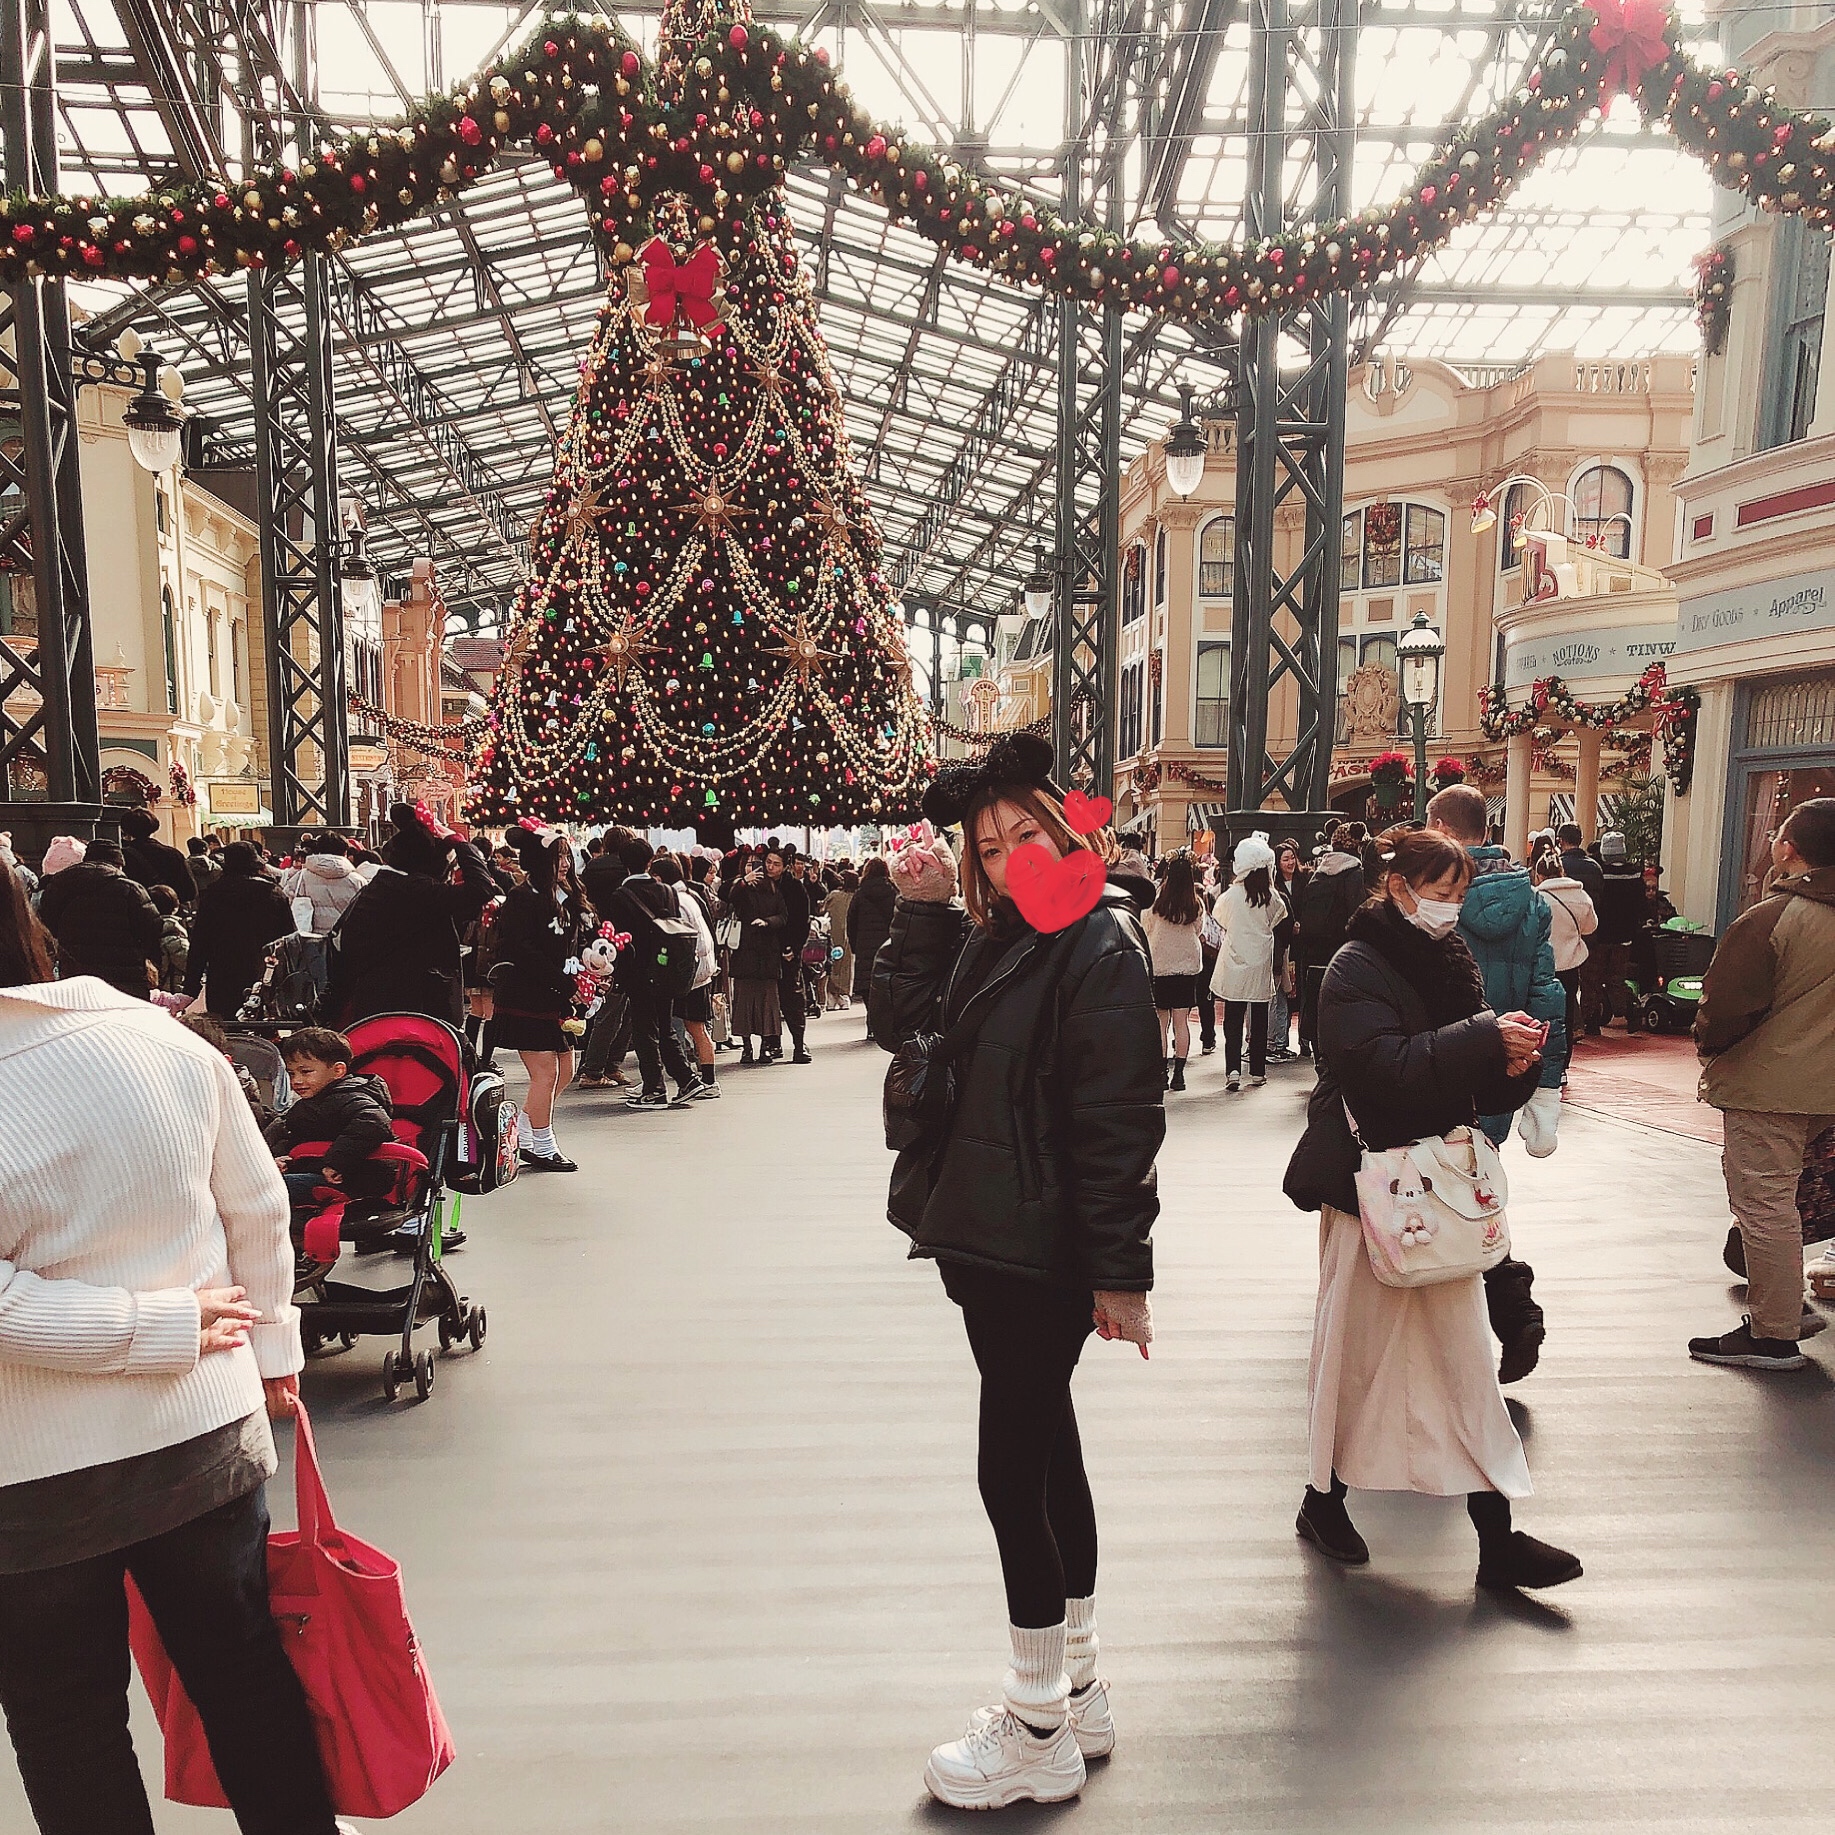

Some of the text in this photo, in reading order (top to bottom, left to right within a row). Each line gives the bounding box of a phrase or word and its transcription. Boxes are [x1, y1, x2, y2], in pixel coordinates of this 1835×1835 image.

[1768, 587, 1824, 618] Apparel
[1552, 643, 1600, 665] NOTIONS
[976, 683, 996, 692] PENNY
